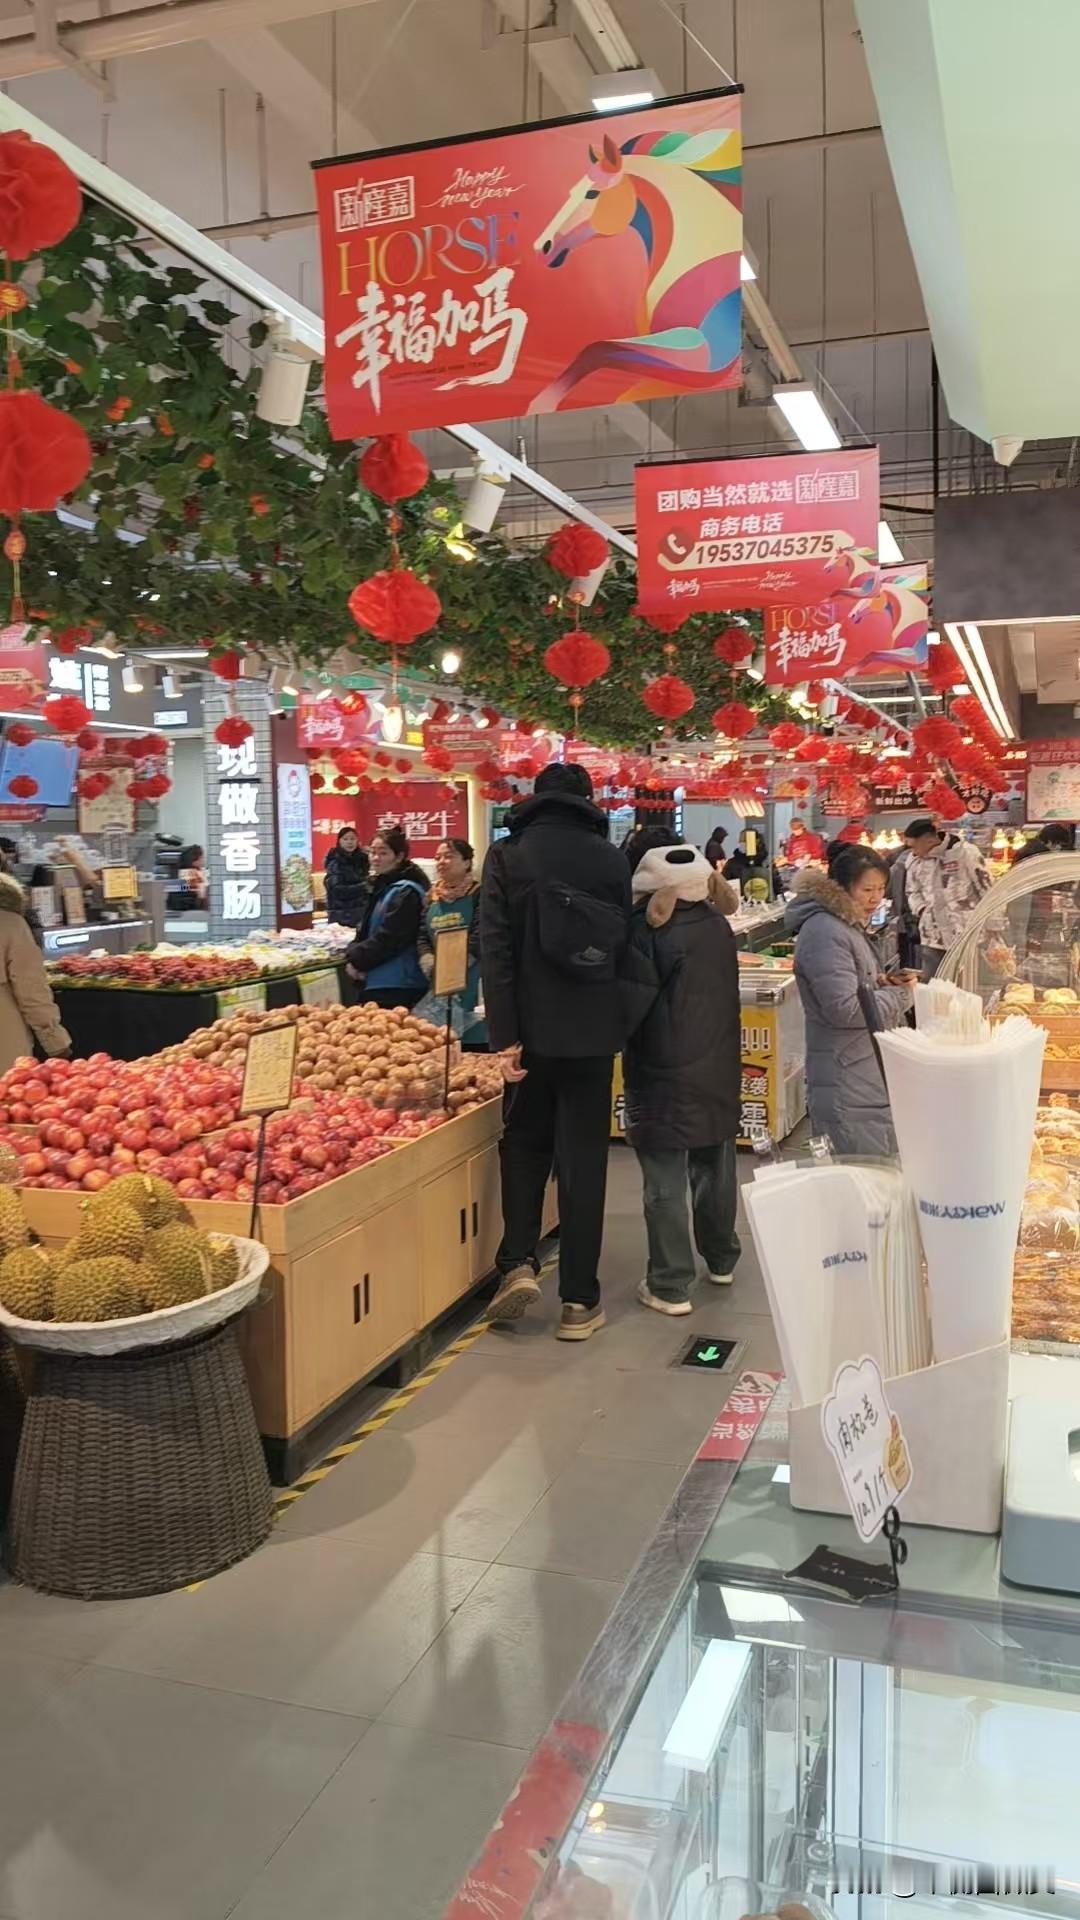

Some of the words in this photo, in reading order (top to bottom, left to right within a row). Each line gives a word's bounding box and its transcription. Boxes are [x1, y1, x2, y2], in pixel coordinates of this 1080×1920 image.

[444, 166, 509, 192] Happy
[336, 211, 521, 295] HORSE
[336, 267, 528, 415] 幸福加马
[657, 481, 793, 512] 团购当然就选
[700, 512, 783, 538] 商务电话
[696, 534, 835, 565] 19537045375
[770, 623, 847, 676] 幸福加马
[217, 736, 261, 920] 现做香肠
